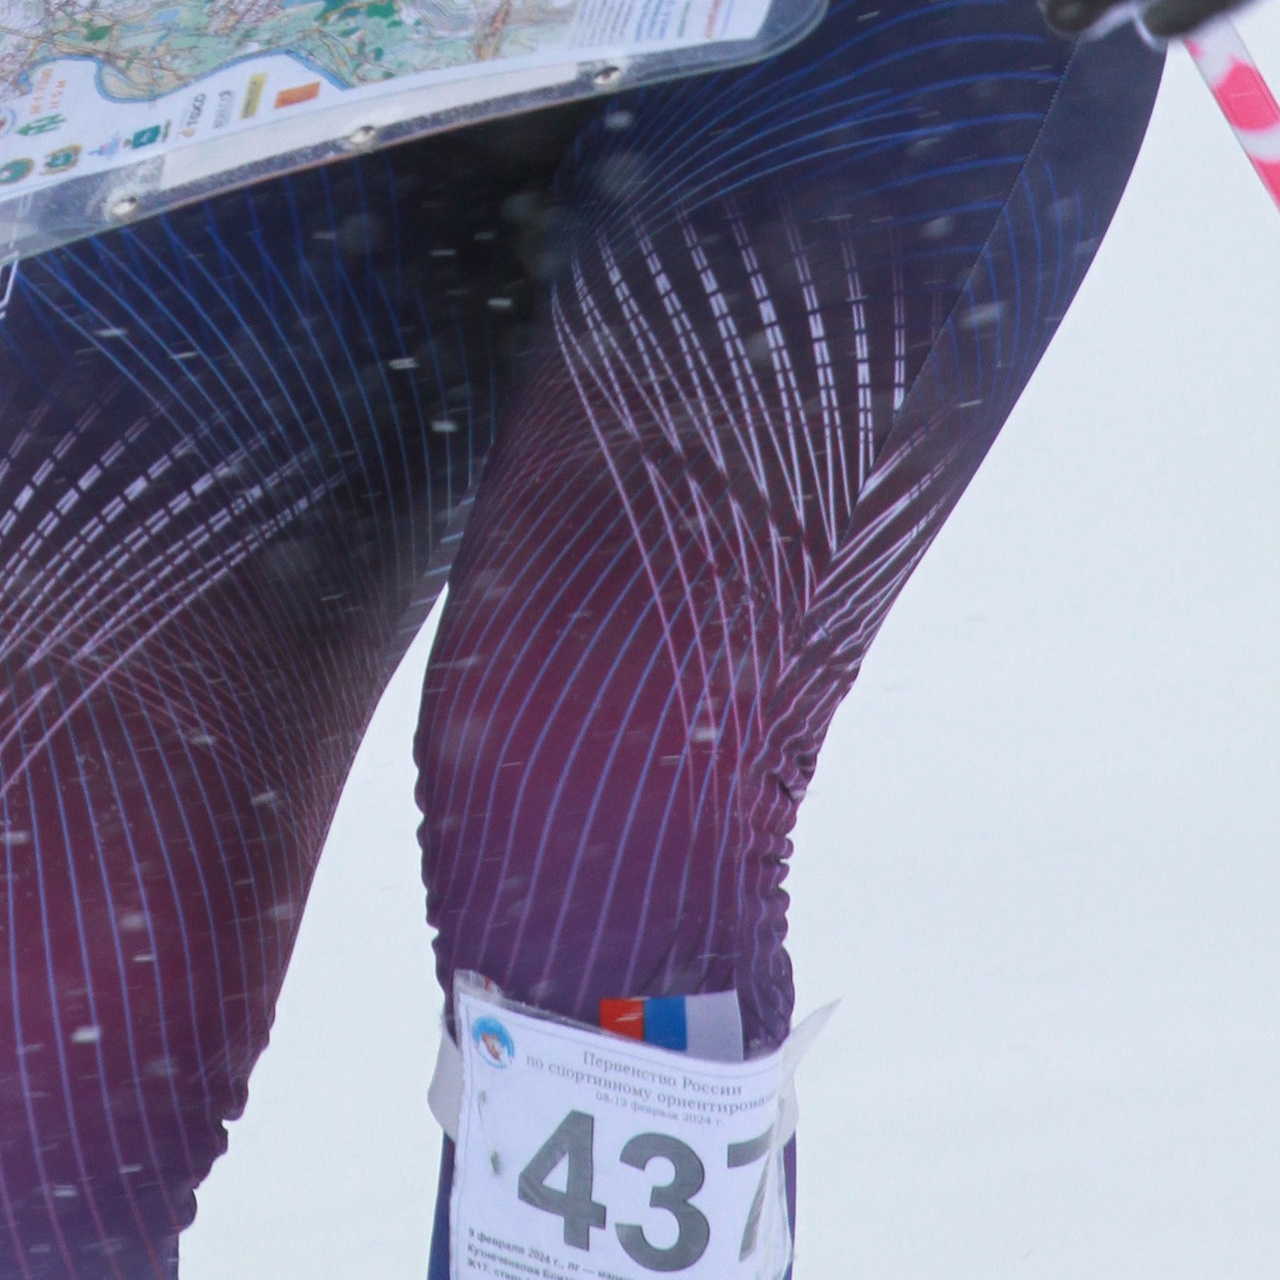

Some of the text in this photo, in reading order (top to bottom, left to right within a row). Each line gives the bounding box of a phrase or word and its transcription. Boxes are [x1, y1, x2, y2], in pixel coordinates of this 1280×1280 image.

[525, 1054, 545, 1070] по
[547, 1062, 652, 1101] спортивному
[583, 1050, 742, 1097] Первенство России
[517, 1108, 775, 1273] 437
